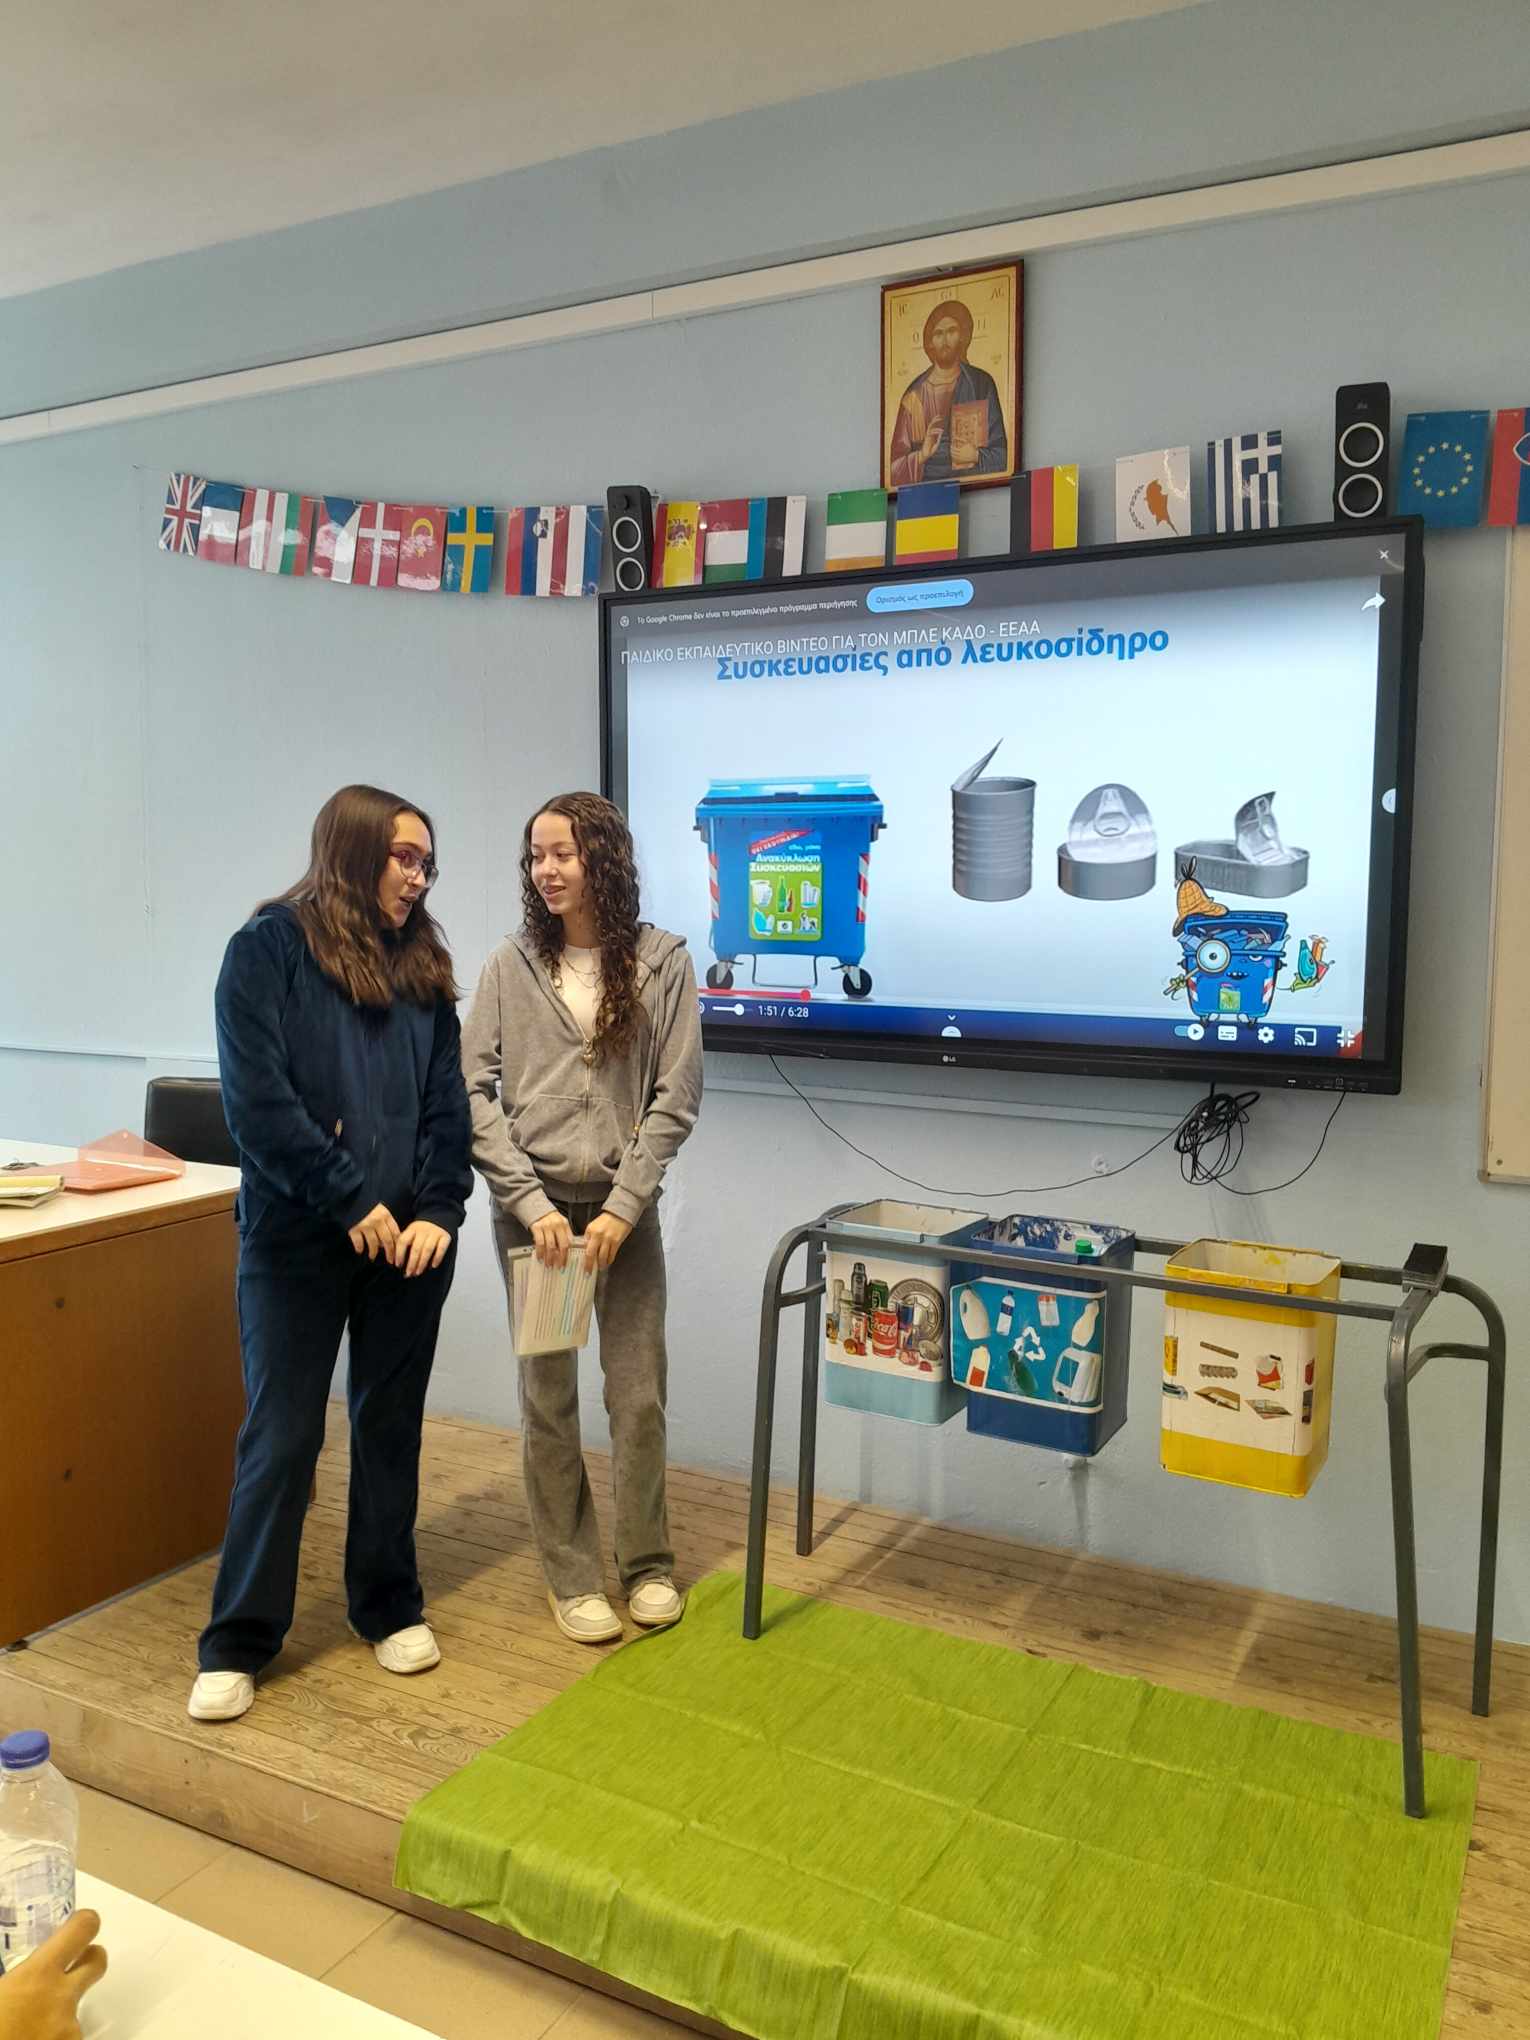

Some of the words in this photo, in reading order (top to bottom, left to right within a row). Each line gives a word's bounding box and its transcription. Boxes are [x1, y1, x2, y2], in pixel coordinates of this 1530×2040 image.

[645, 614, 668, 625] Google
[668, 612, 692, 622] Chrome
[693, 611, 705, 620] δεν
[705, 608, 721, 619] είναι
[722, 610, 730, 618] το
[731, 605, 778, 618] προεπιλεγμένο
[779, 602, 818, 615] πρόγραμμα
[819, 599, 858, 610] περιήγησης
[621, 647, 673, 665] ΠΑΙΔΙΚΟ
[677, 639, 773, 661] ΕΚΠΑΙΔΕΥΤΙΚΟ
[777, 636, 828, 654] ΒΙΝΤΕΟ
[832, 634, 855, 650] ΓΙΑ
[858, 631, 889, 648] ΤΟΝ
[893, 627, 938, 645] ΜΠΛΕ
[942, 623, 986, 642] ΚΑΔΟ
[1000, 619, 1041, 638] ΕΕΑΑ
[717, 645, 889, 681] Συσκευασίες
[896, 640, 952, 669] από
[961, 627, 1169, 665] λευκοσίδηρο
[758, 1004, 778, 1017] 1:51
[787, 1006, 809, 1018] 6:28
